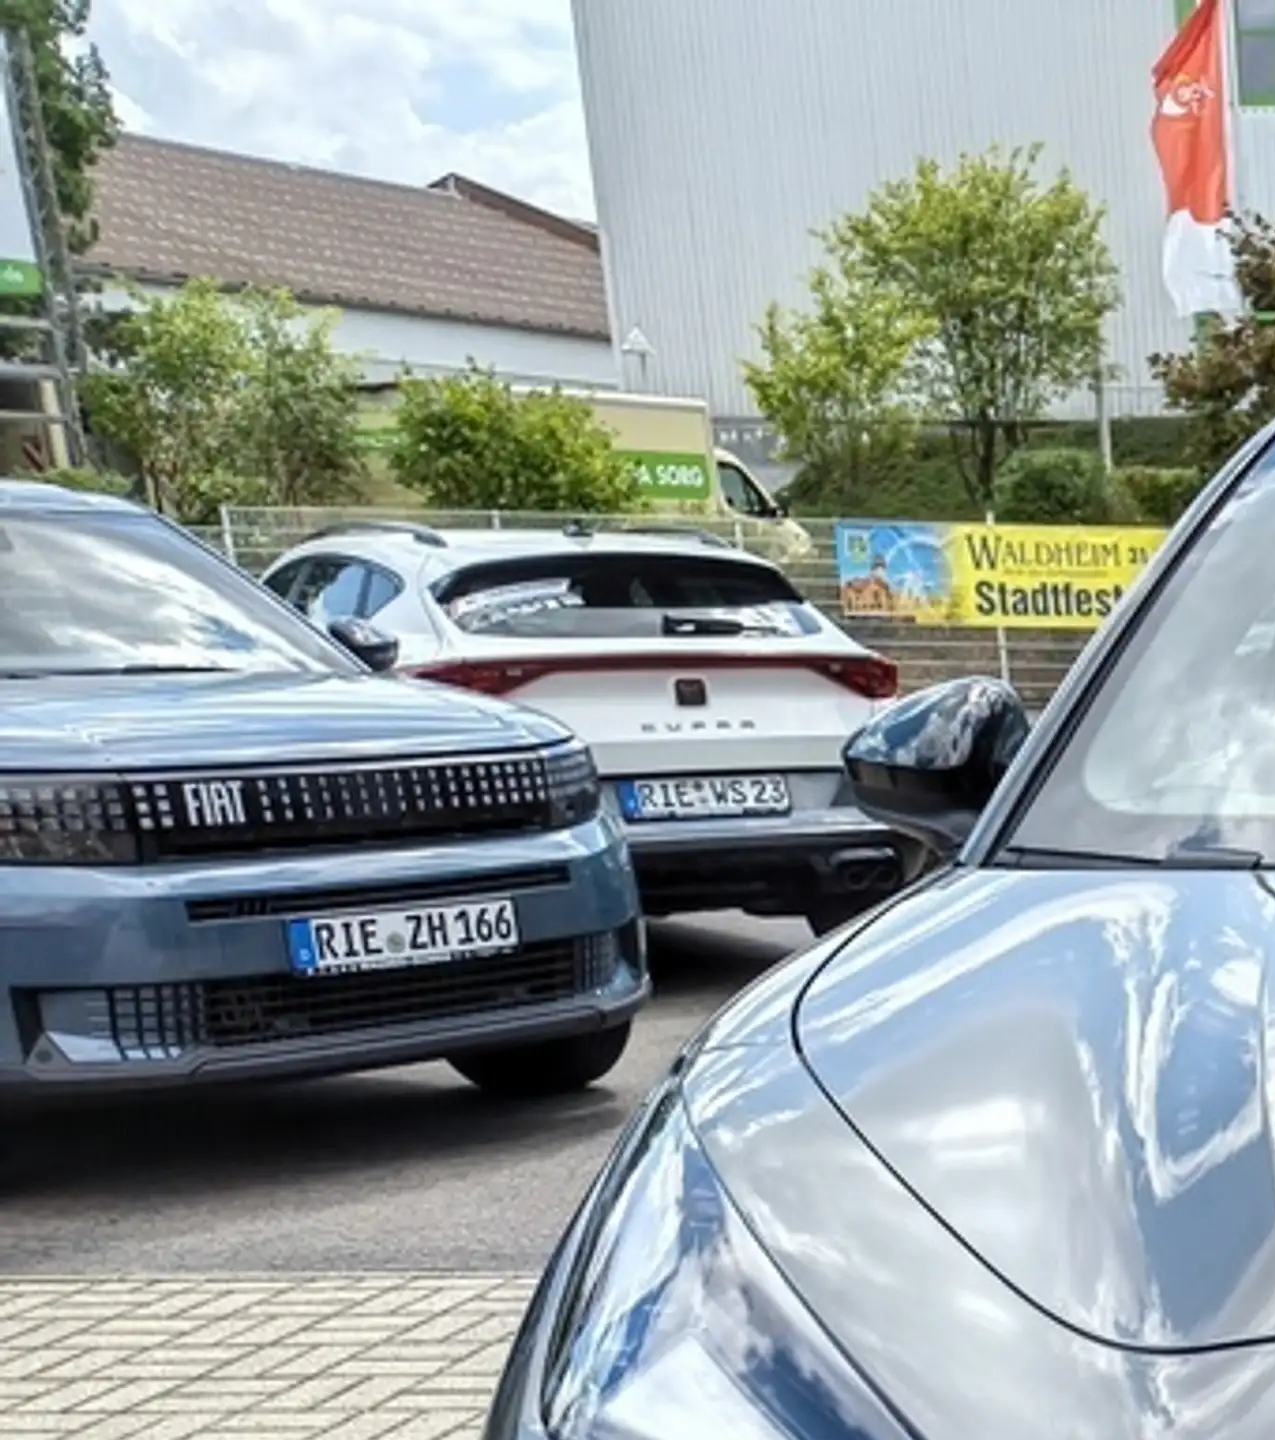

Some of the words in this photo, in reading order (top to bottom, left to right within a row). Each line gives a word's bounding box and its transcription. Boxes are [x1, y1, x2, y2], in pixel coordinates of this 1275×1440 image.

[183, 781, 246, 827] FIAT
[637, 782, 696, 808] RIE
[709, 779, 748, 805] WS
[315, 918, 383, 961] RIE
[405, 911, 450, 950] ZH
[454, 904, 512, 945] 166
